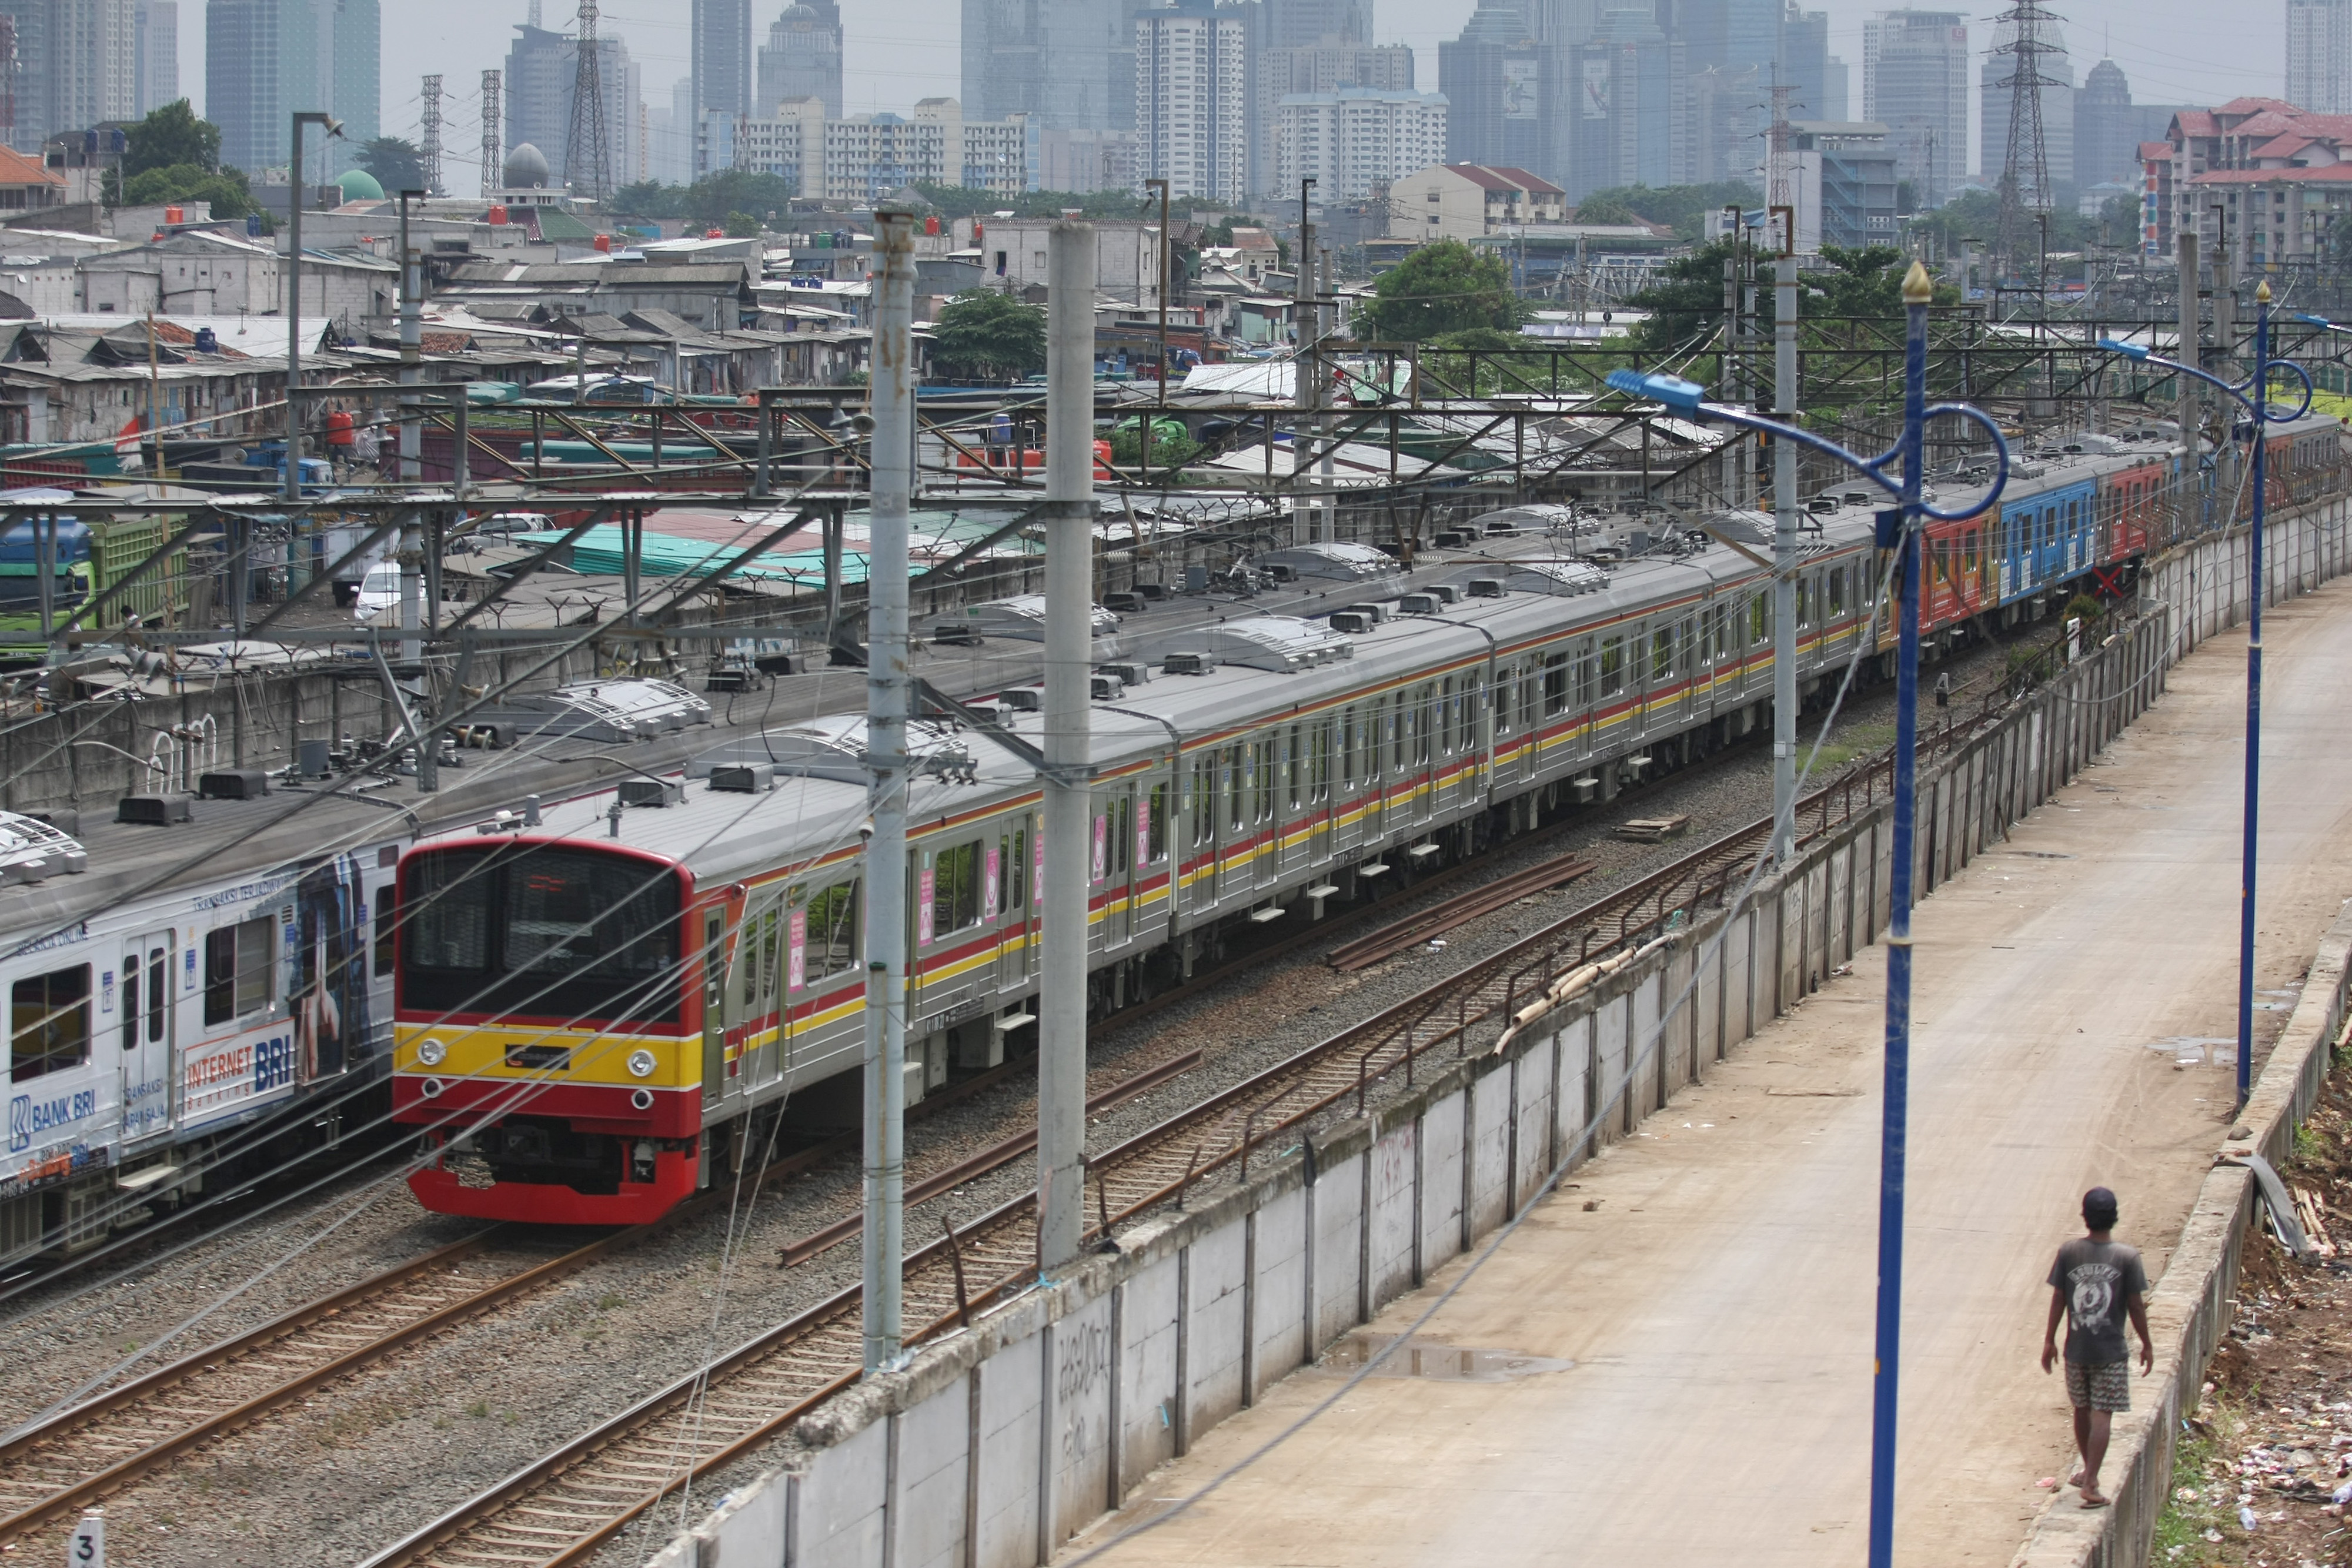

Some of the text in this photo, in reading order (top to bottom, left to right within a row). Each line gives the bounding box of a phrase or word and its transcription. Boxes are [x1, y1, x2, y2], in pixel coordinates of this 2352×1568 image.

[188, 1045, 252, 1091] INTERNET
[255, 1034, 291, 1093] BRI
[125, 1078, 163, 1100] RANSAKSI
[188, 1082, 250, 1110] Banking
[34, 1089, 96, 1132] BANK BRI
[77, 1535, 95, 1561] 3
